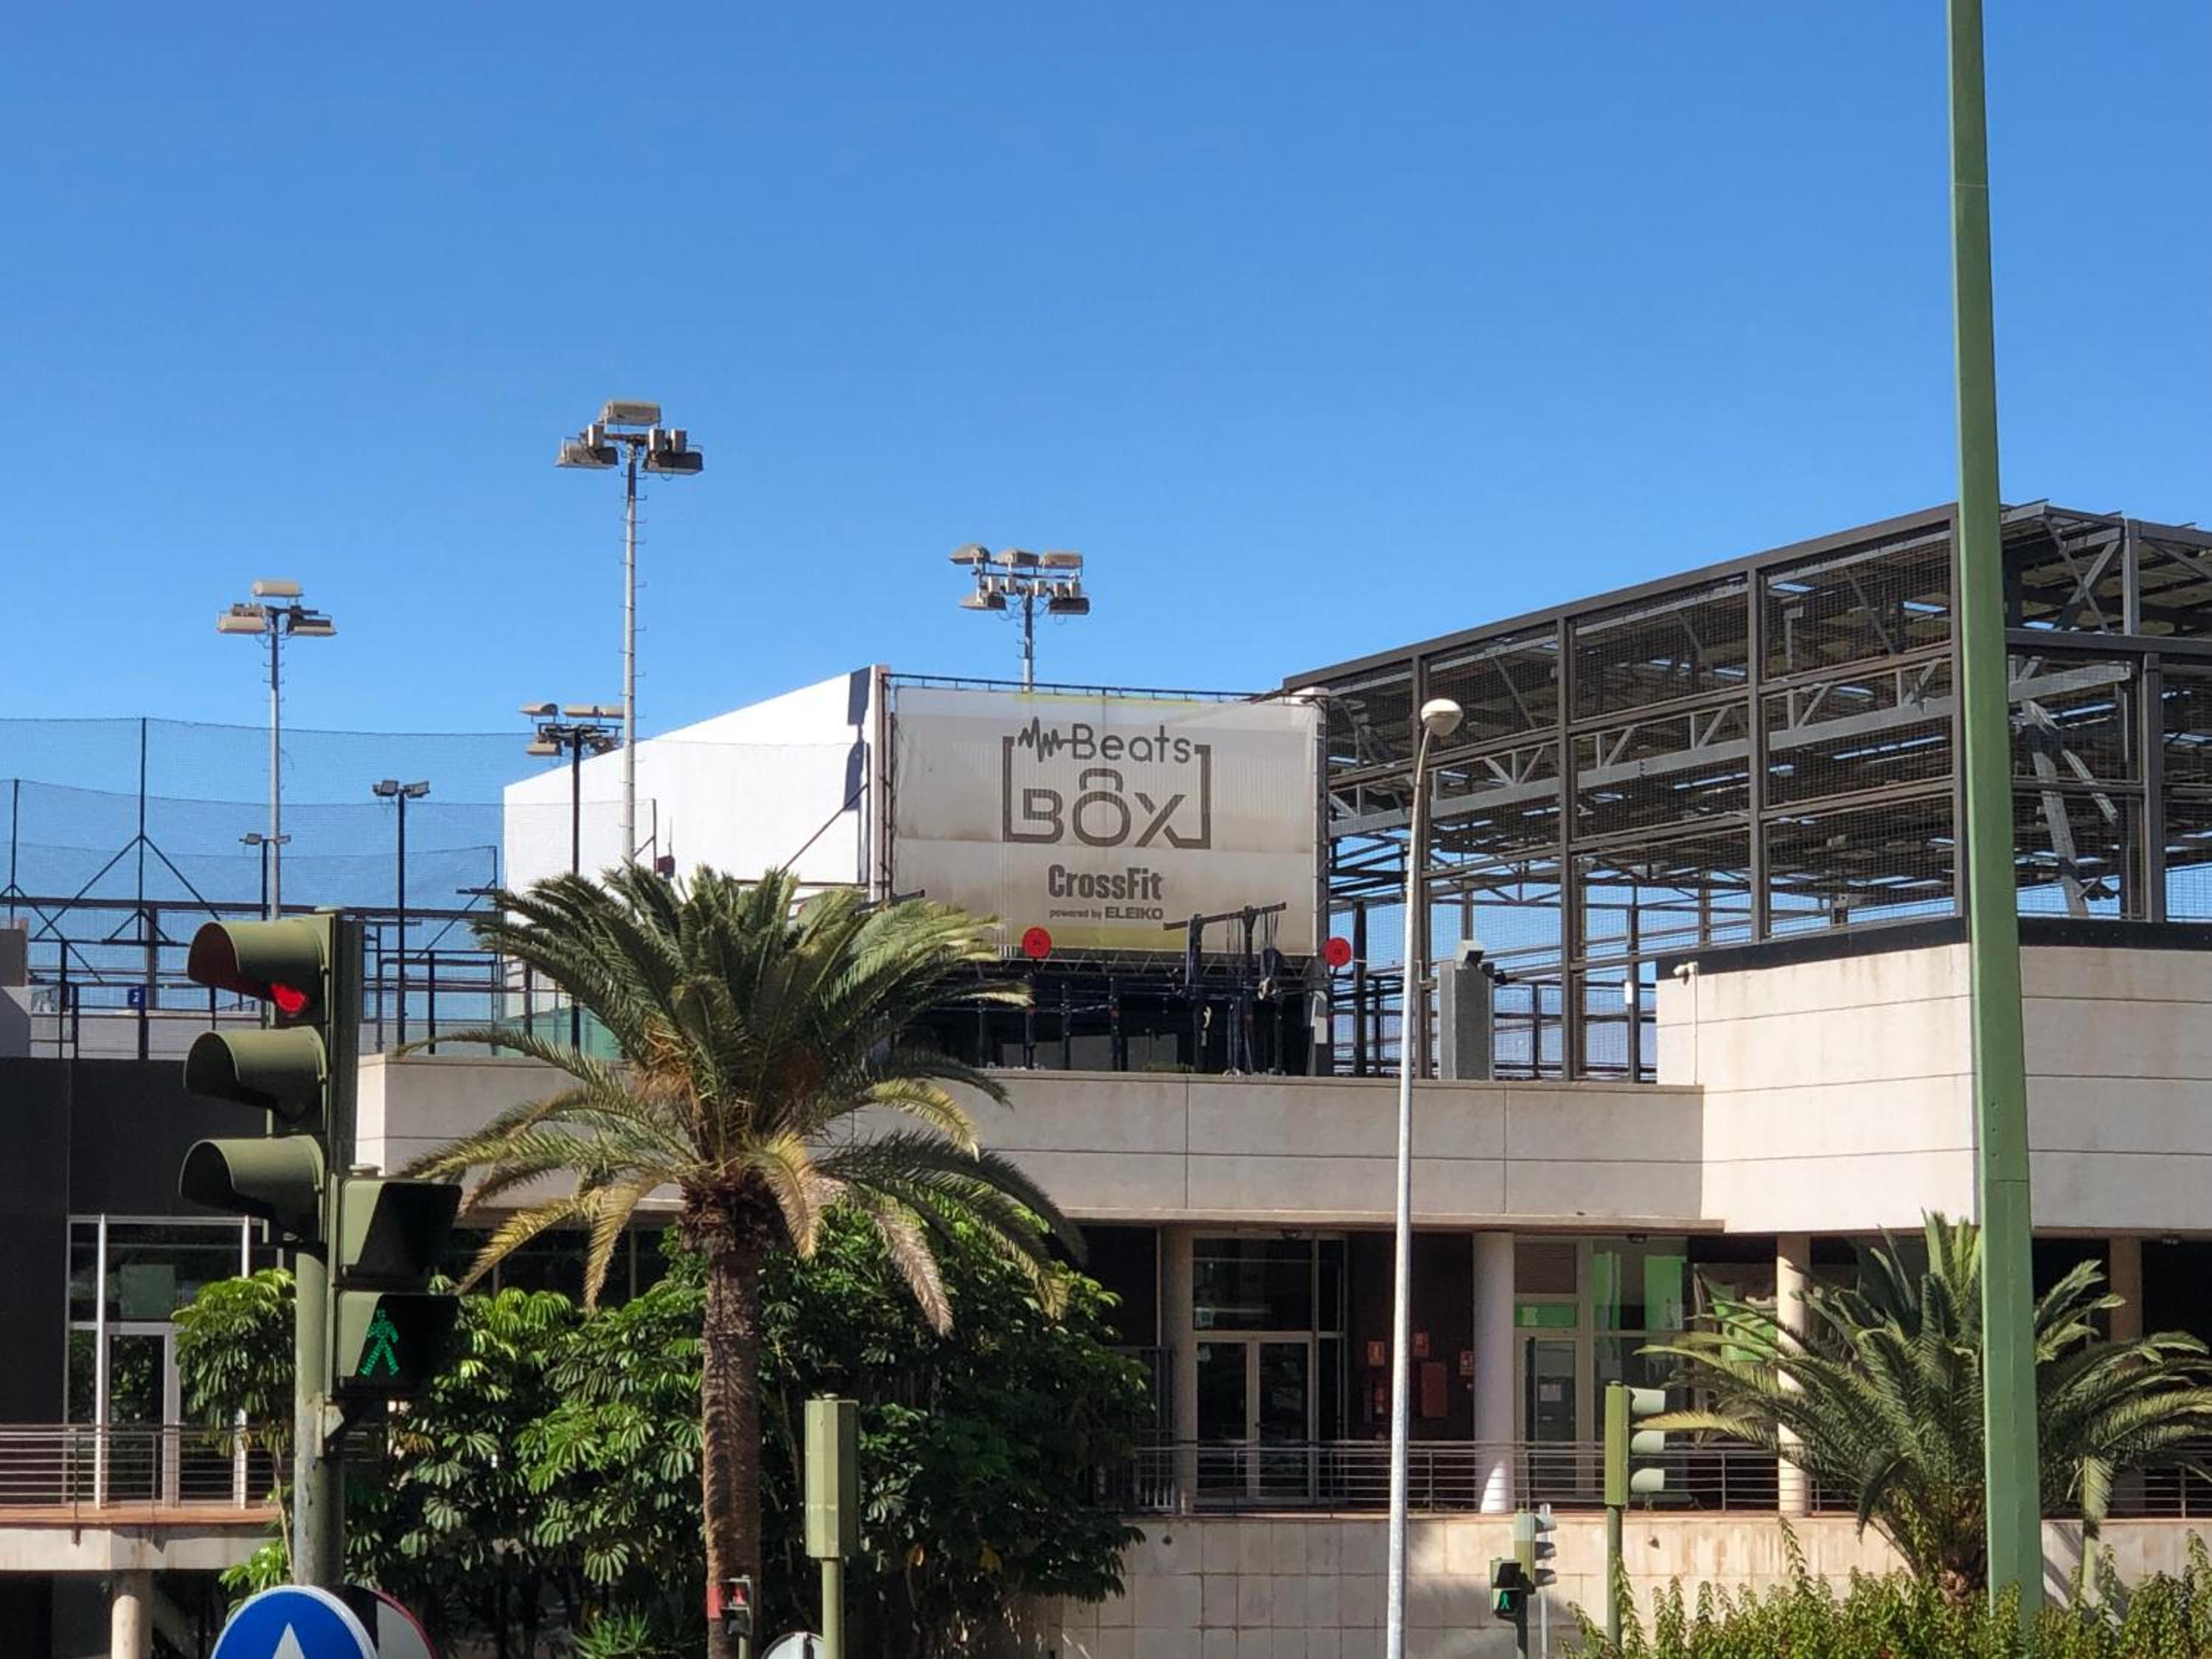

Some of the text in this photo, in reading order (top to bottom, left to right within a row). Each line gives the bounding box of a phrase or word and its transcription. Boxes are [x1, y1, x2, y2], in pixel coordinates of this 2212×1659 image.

[1071, 723, 1192, 764] Beats
[1022, 786, 1188, 849] BOX
[1048, 863, 1163, 901] CrossFit
[1049, 906, 1164, 921] powered by ELEIKO
